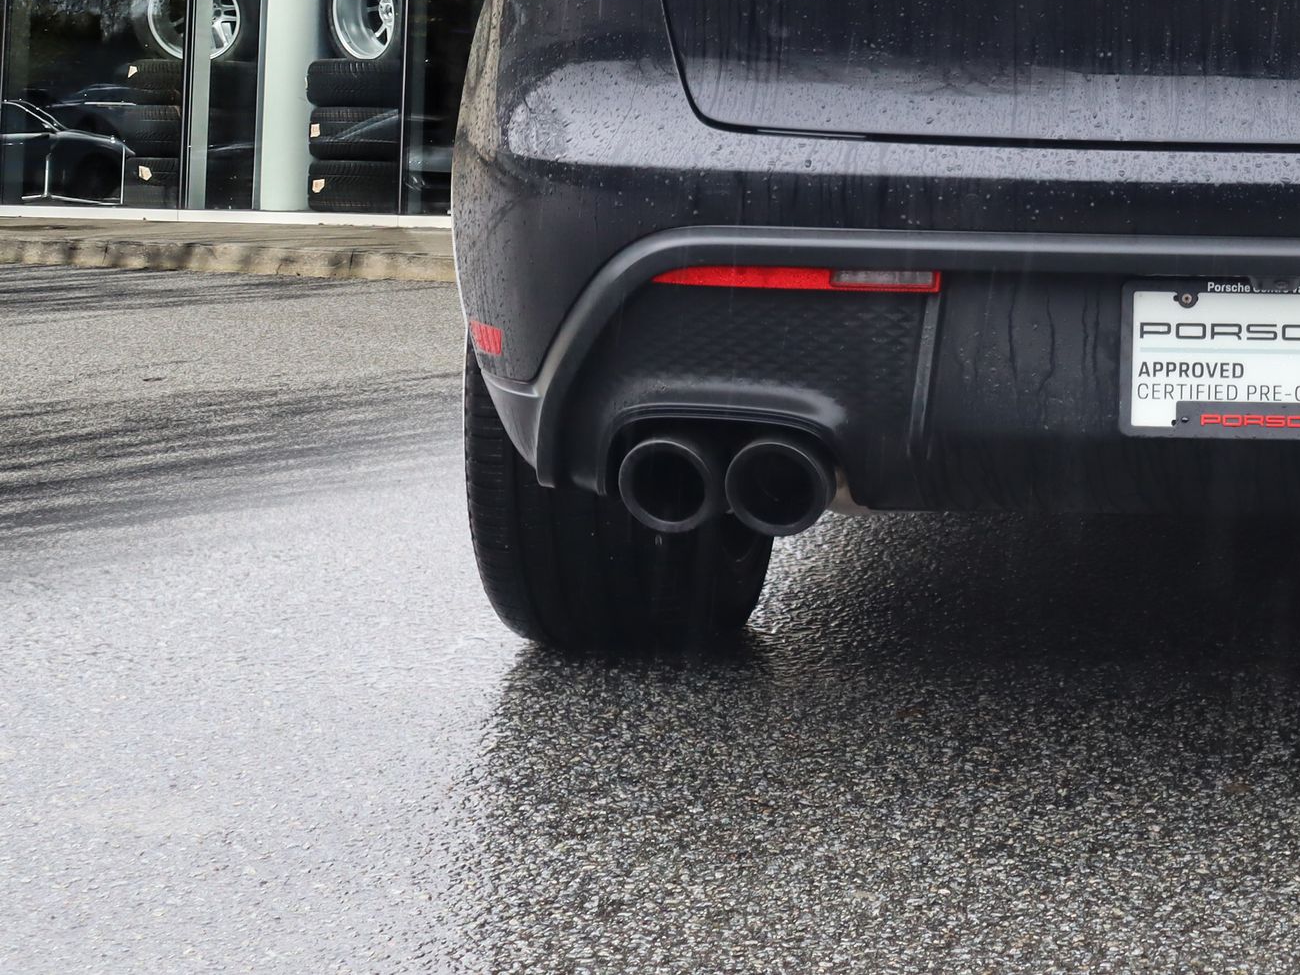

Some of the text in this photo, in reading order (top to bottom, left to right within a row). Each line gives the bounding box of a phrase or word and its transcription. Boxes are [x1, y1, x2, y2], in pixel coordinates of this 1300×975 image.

[1207, 281, 1251, 293] Porsche
[1138, 362, 1244, 379] APPROVED
[1137, 383, 1238, 401] CERTIFIED
